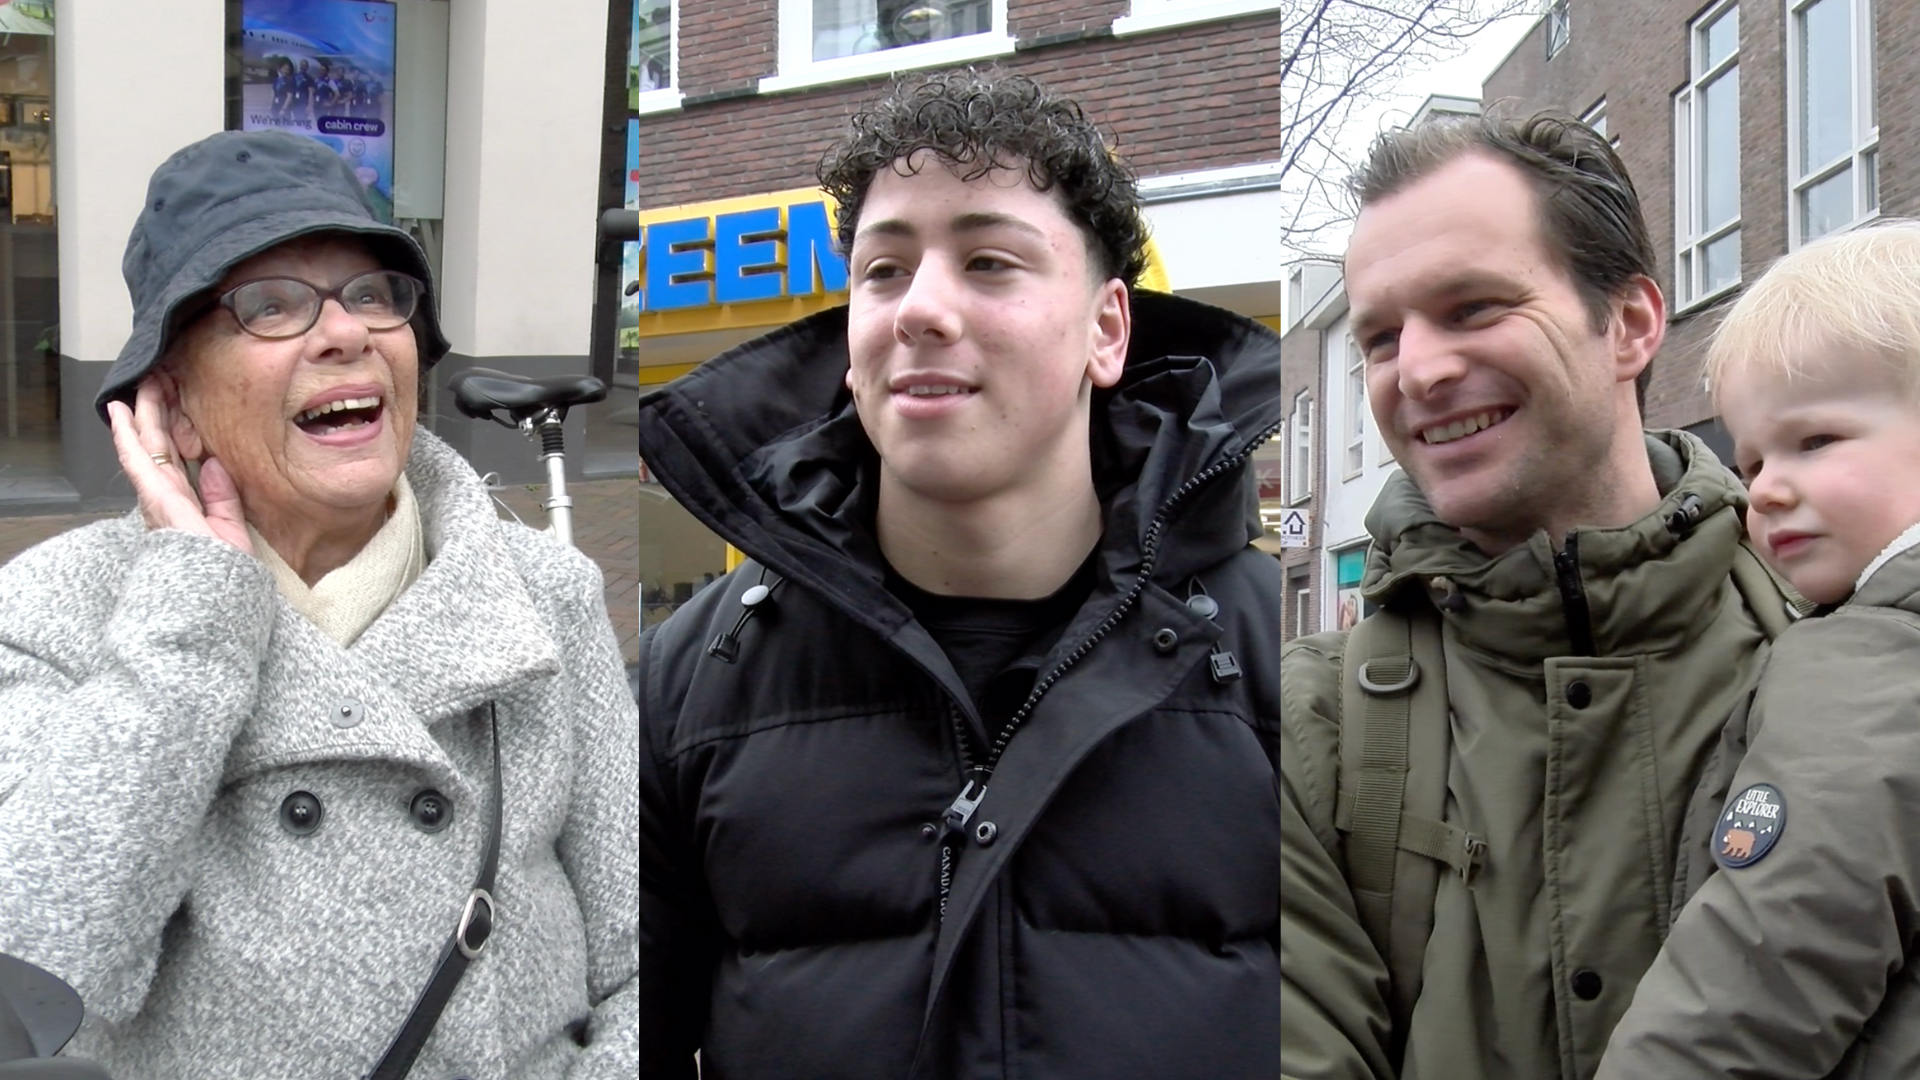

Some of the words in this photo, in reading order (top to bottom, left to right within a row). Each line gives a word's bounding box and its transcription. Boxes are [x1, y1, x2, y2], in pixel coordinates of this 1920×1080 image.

[250, 114, 280, 126] We're
[282, 115, 312, 130] hiring
[325, 119, 352, 131] cabin
[354, 121, 378, 132] crew
[1746, 789, 1770, 802] LITTLE
[1735, 799, 1779, 819] EXPLORER
[941, 846, 951, 895] CANADA
